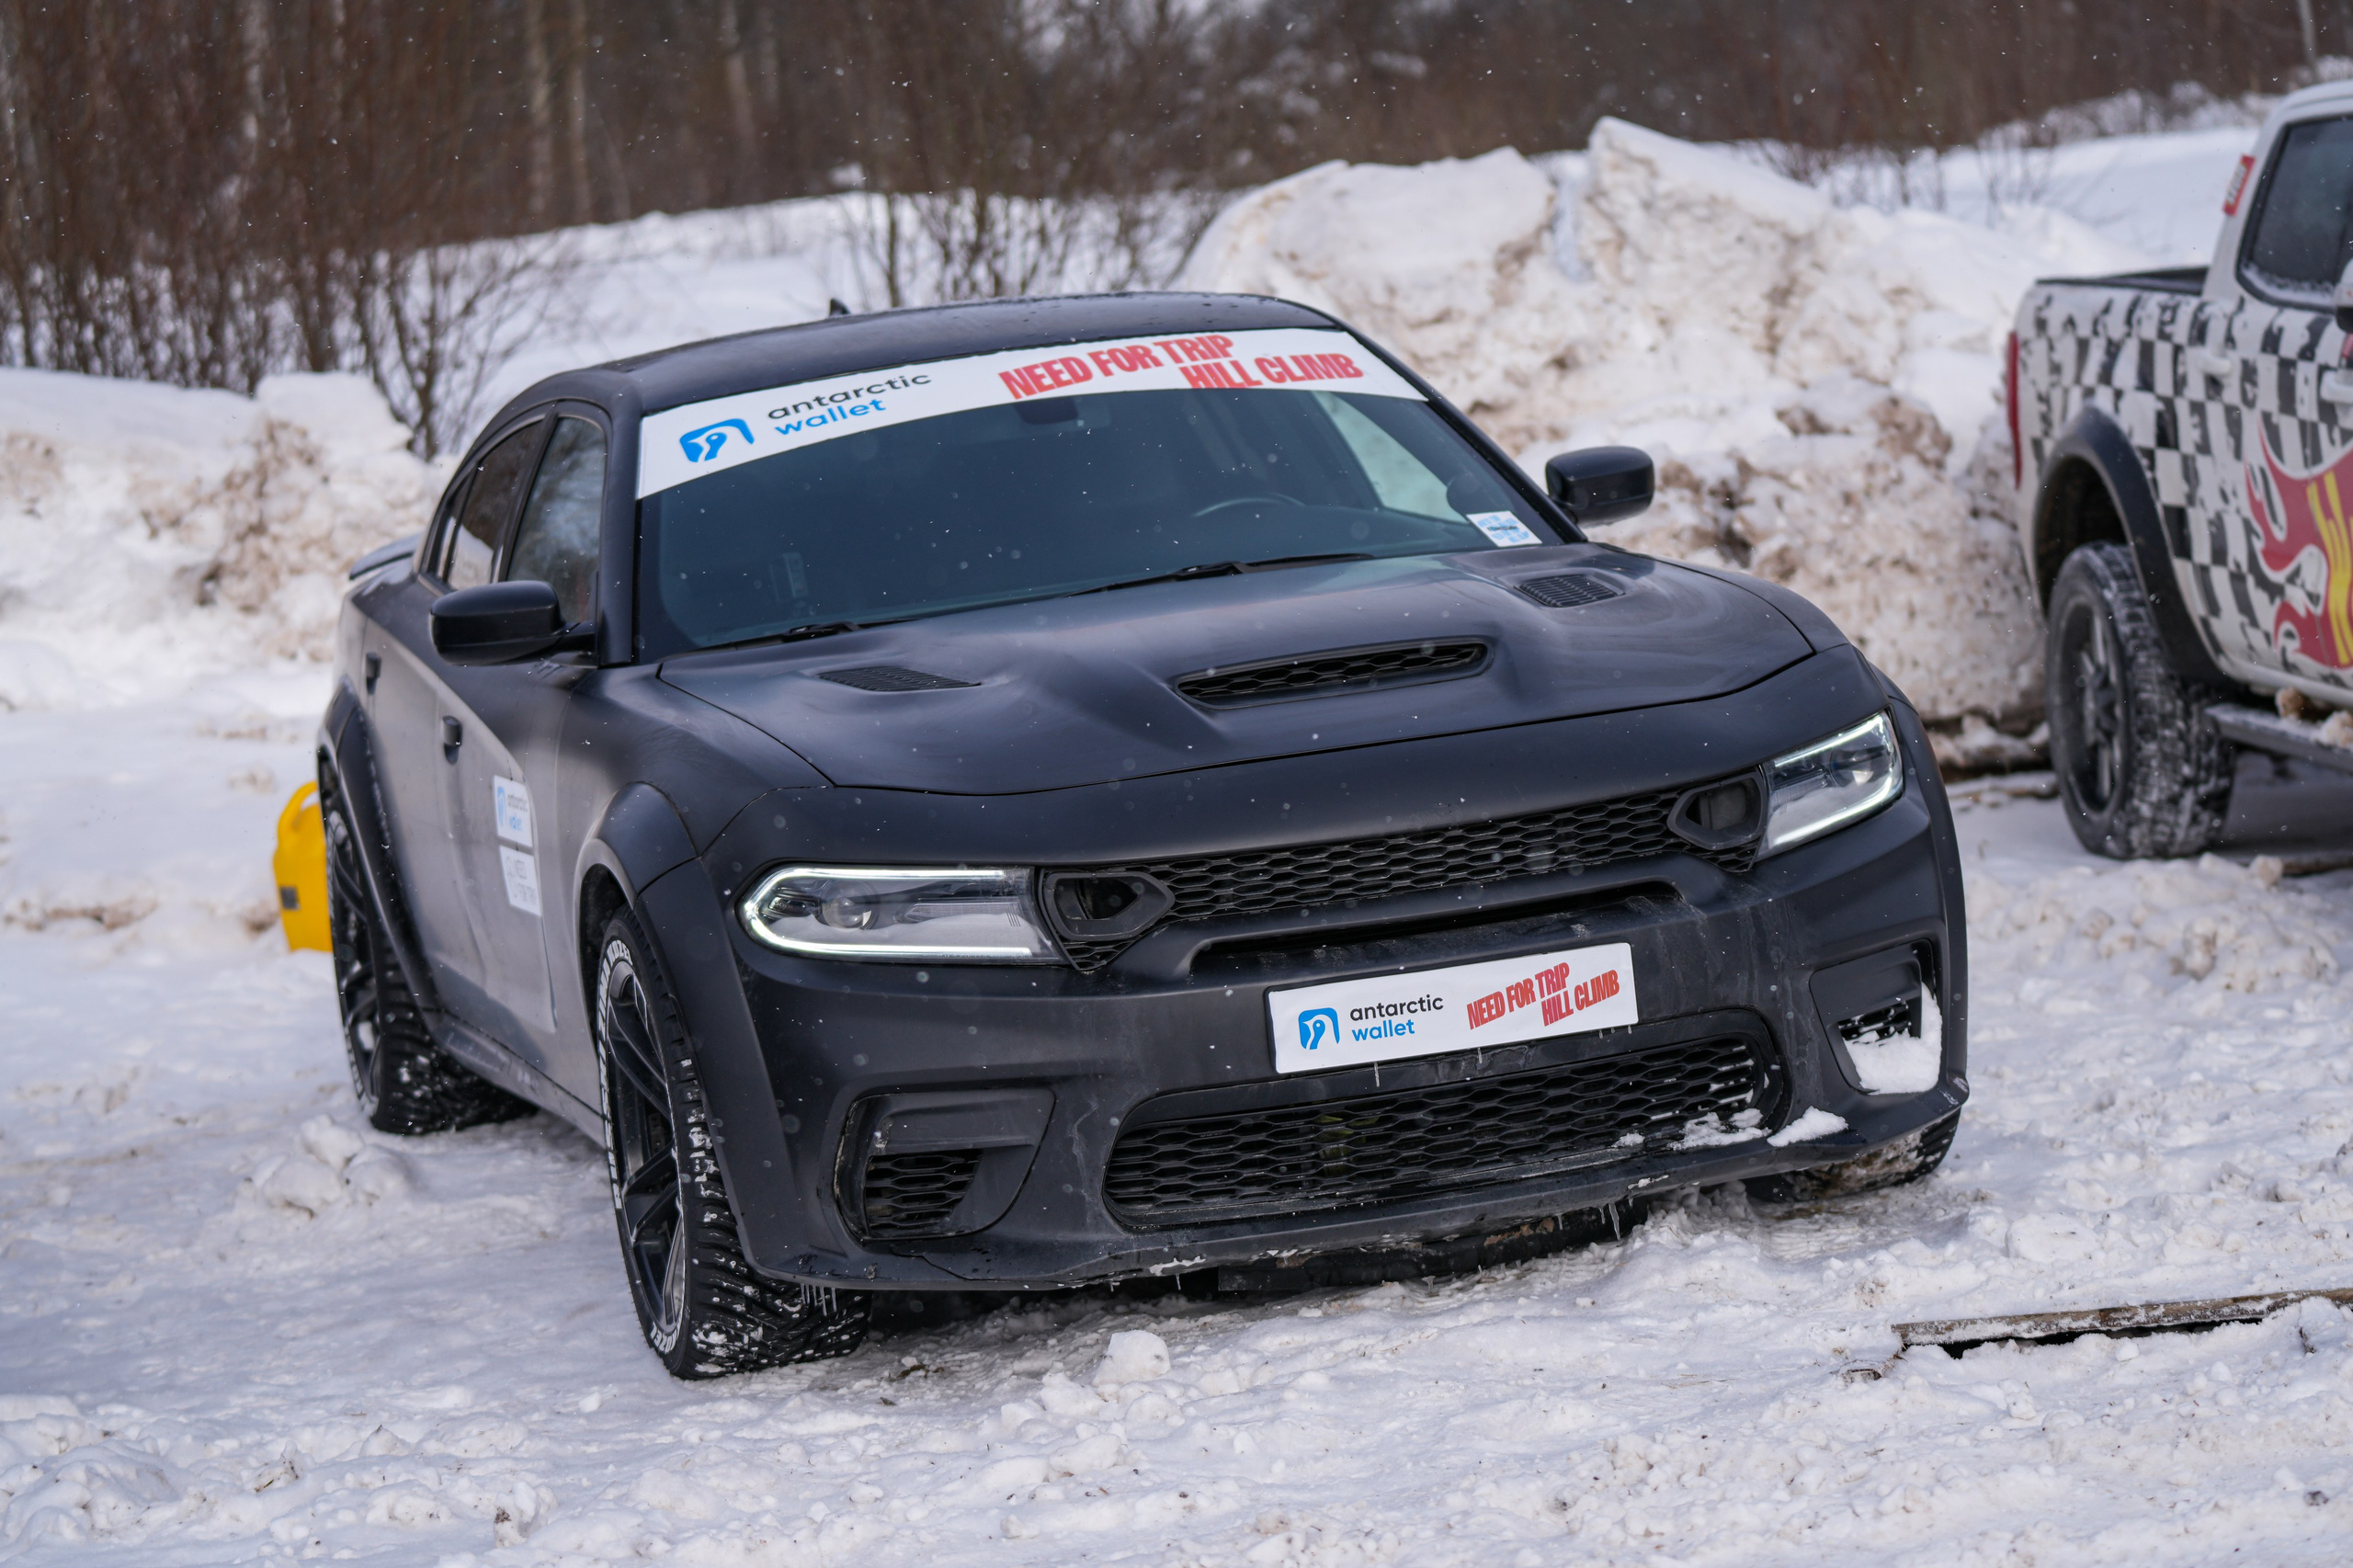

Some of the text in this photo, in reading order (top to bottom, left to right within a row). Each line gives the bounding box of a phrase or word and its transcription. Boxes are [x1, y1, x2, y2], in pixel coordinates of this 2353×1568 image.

[999, 335, 1233, 398] NEED FOR TRIP
[1179, 354, 1364, 388] HILL CLIMB
[768, 372, 932, 420] antarctic
[774, 398, 887, 436] wallet
[1349, 994, 1444, 1021] antarctic
[1467, 961, 1570, 1030] NEED FOR TRIP
[1541, 970, 1620, 1027] HILL CLIMB
[1351, 1019, 1415, 1042] wallet
